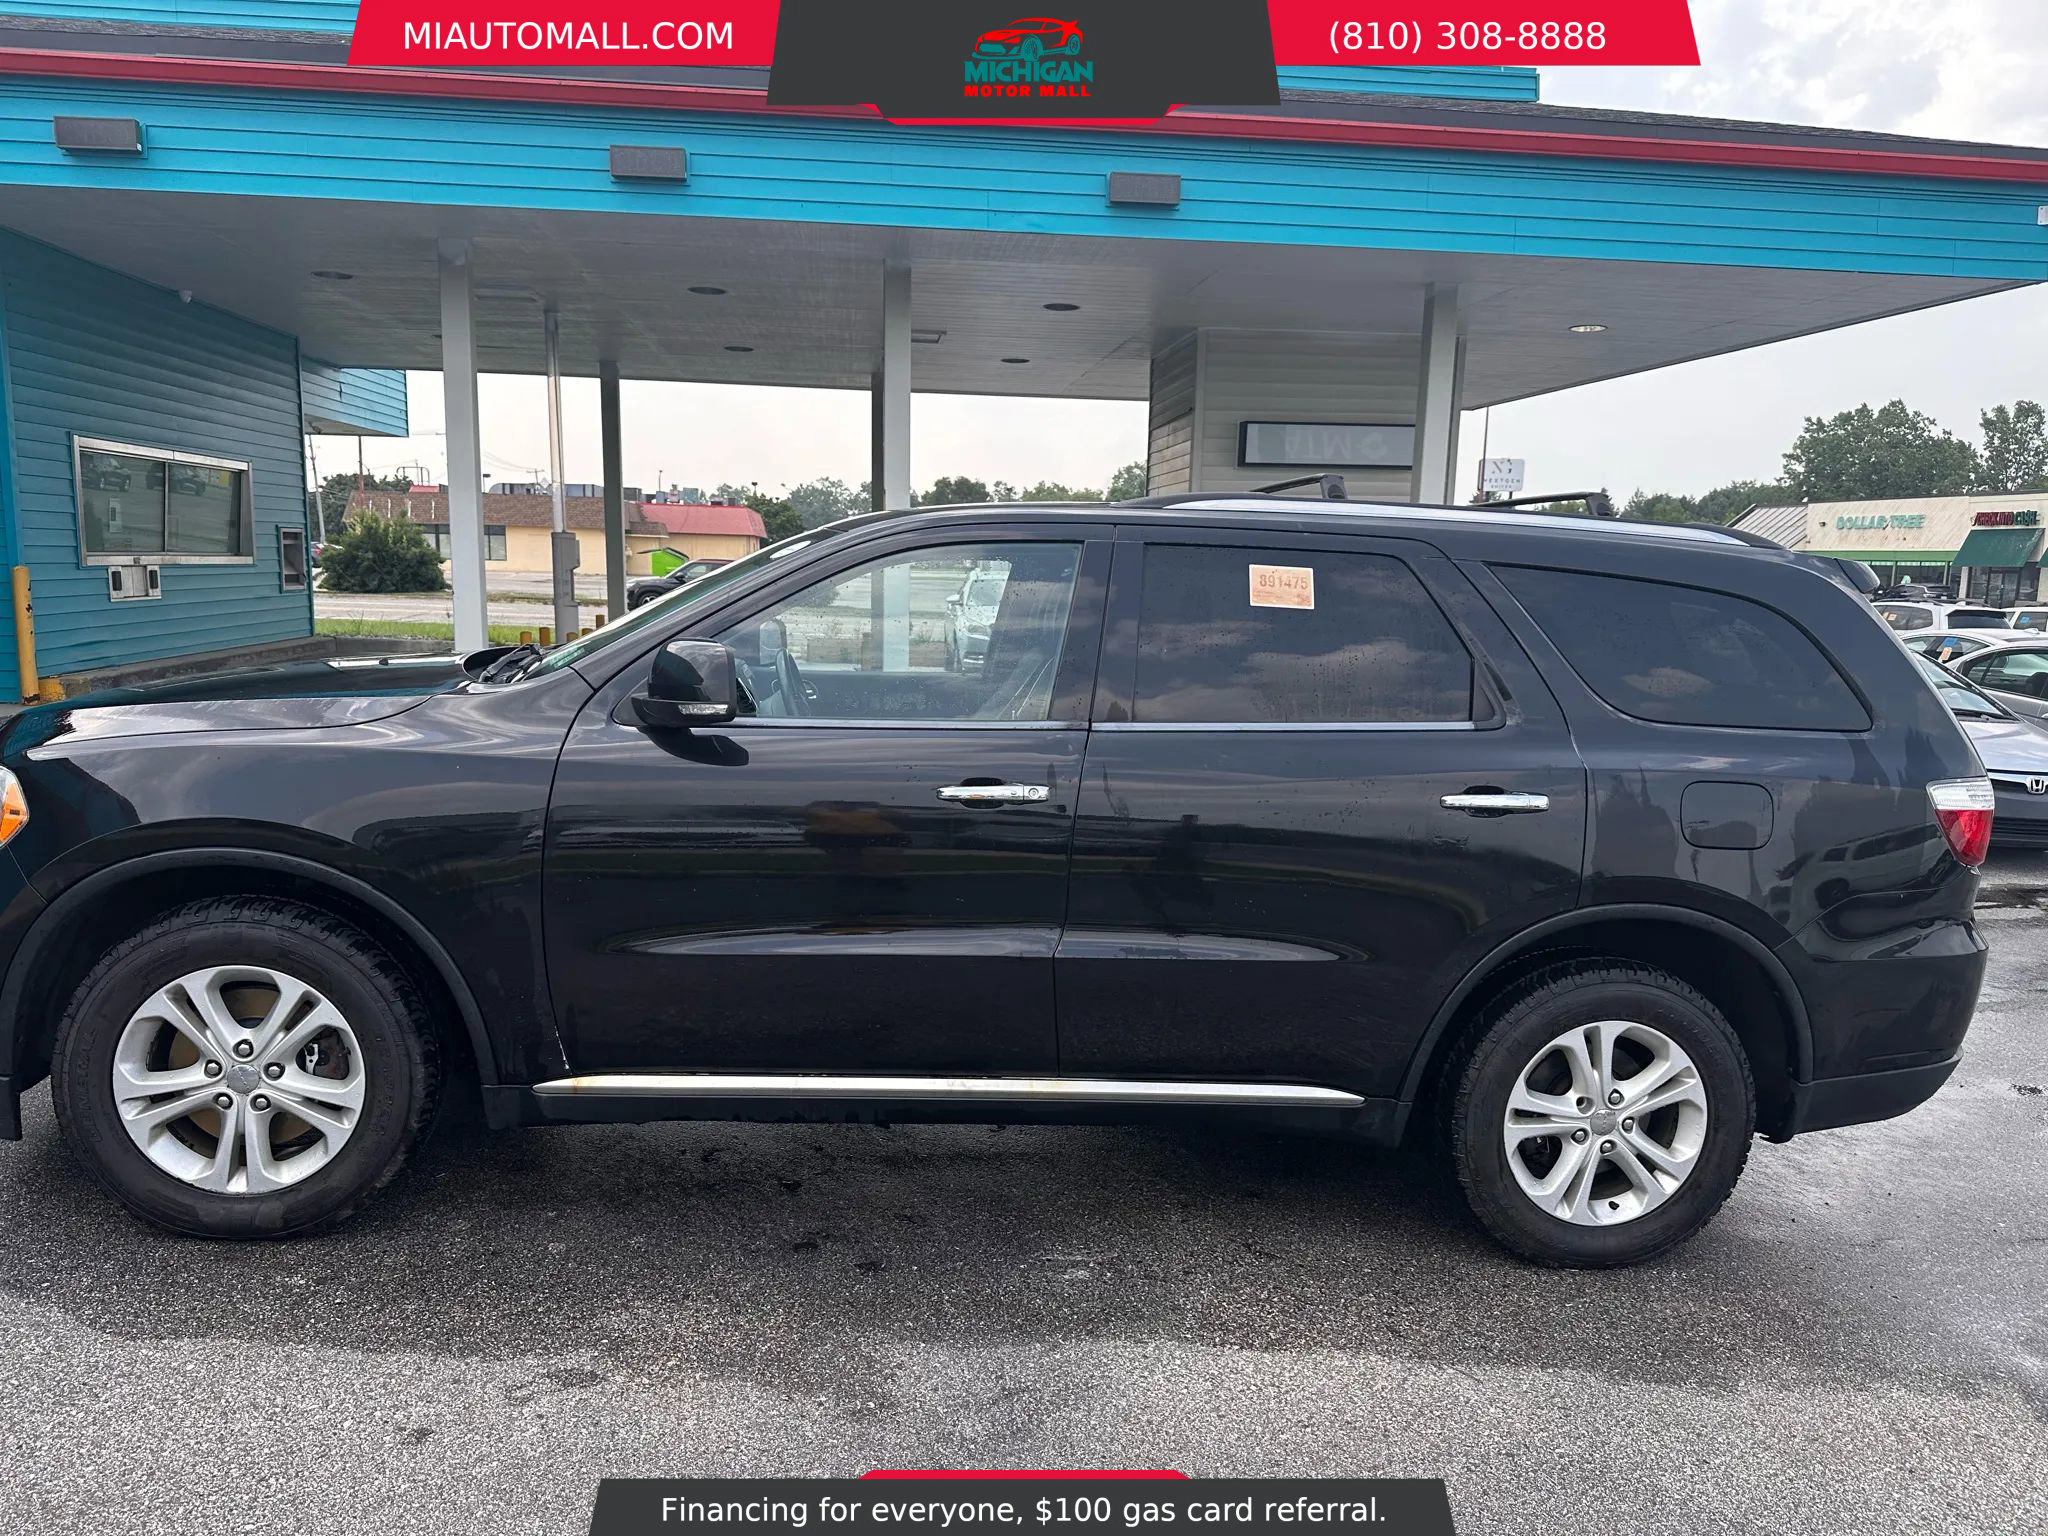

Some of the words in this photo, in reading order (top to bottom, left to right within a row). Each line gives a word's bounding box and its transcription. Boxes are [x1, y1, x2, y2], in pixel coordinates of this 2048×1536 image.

[1836, 515, 1888, 530] DOLLAR
[1890, 514, 1926, 528] TREE
[1259, 574, 1308, 590] 891475
